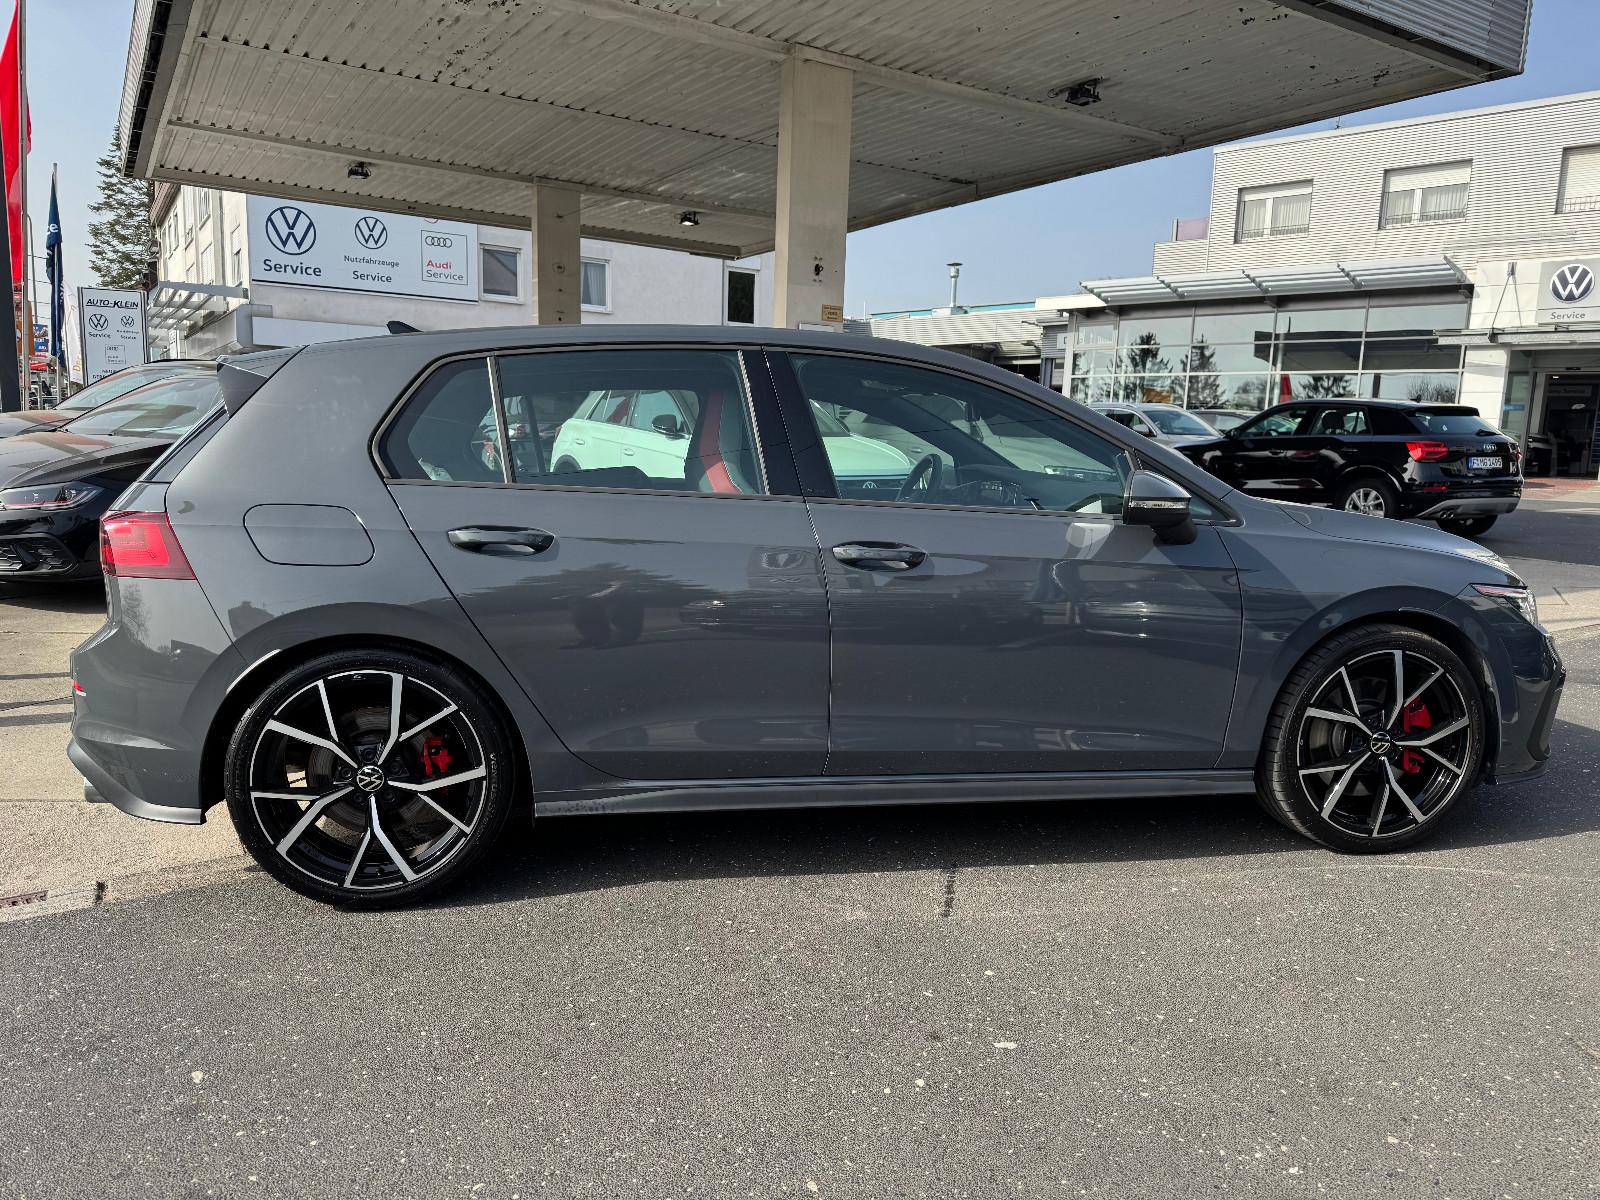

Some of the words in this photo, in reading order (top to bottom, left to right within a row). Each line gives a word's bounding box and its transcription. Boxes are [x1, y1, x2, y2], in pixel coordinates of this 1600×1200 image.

[343, 254, 400, 268] Nutzfahrzeuge
[426, 259, 452, 270] Audi
[263, 258, 322, 277] Service
[352, 270, 392, 283] Service
[426, 269, 464, 281] Service
[86, 298, 139, 309] AUTO-KLEIN
[1550, 311, 1586, 320] Service
[88, 331, 111, 339] Service
